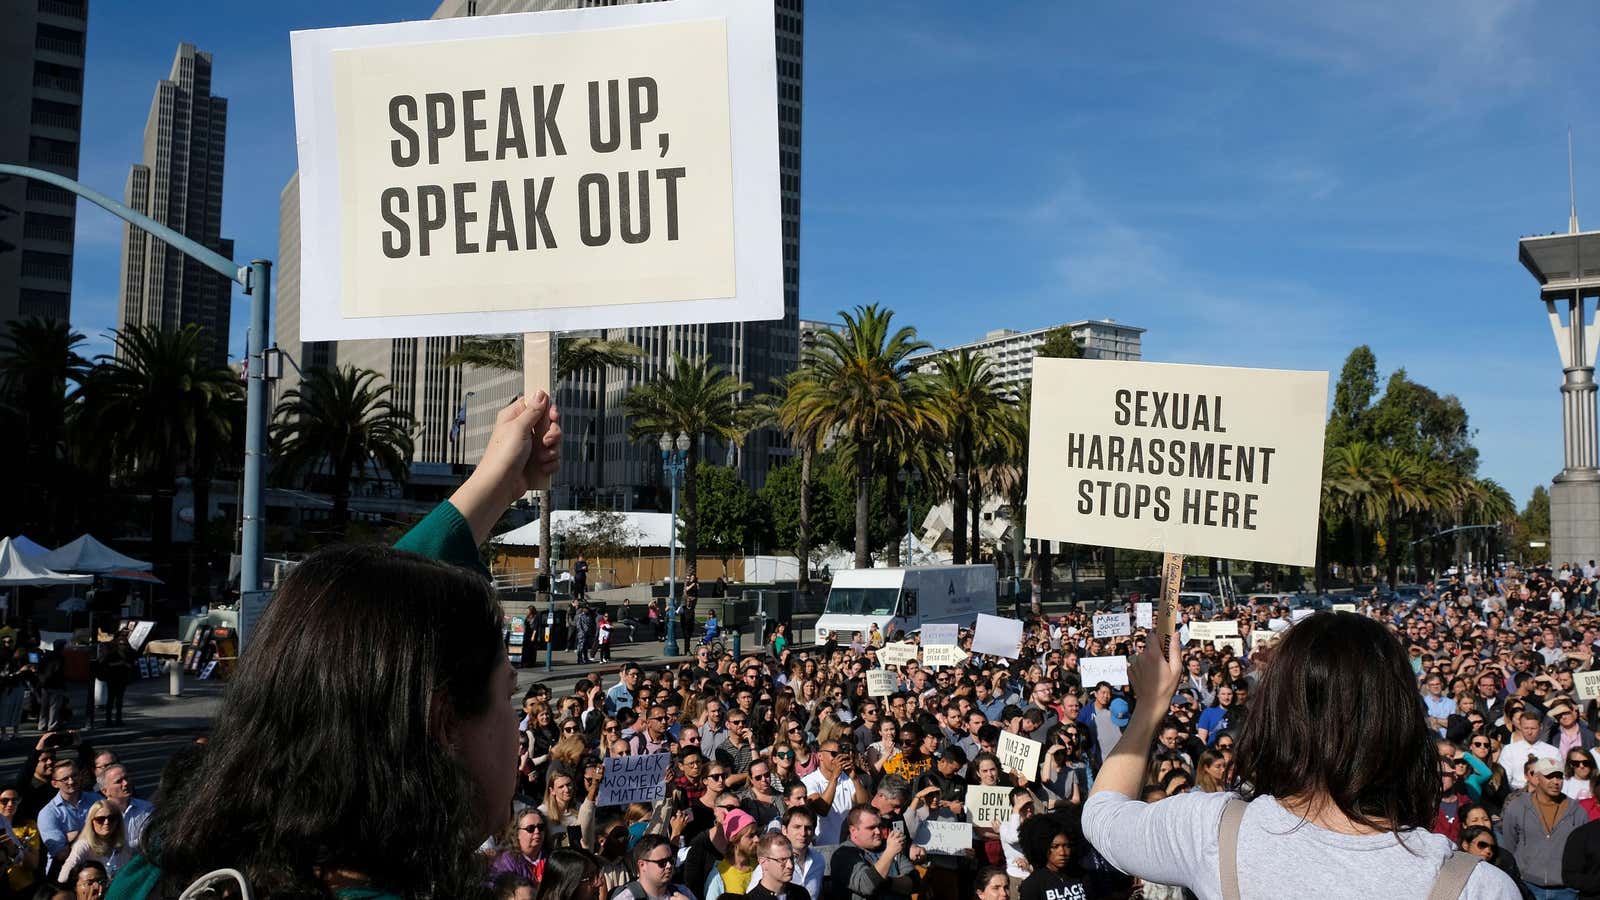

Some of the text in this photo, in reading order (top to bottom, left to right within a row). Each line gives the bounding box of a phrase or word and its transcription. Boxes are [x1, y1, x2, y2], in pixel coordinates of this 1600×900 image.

[388, 76, 670, 168] SPEAK UP,
[380, 166, 686, 259] SPEAK OUT
[1114, 389, 1227, 433] SEXUAL
[1067, 432, 1276, 485] HARASSMENT
[1077, 479, 1259, 531] STOPS HERE
[1111, 627, 1121, 635] IT
[1585, 686, 1595, 696] BE
[1005, 738, 1031, 758] BE EVIL
[612, 755, 663, 772] BLACK
[1003, 753, 1025, 772] DON'T
[604, 773, 661, 788] WOMEN
[610, 786, 664, 802] MATTER
[982, 792, 1011, 806] DON'
[978, 807, 991, 821] BE
[1045, 883, 1085, 900] BLACK
